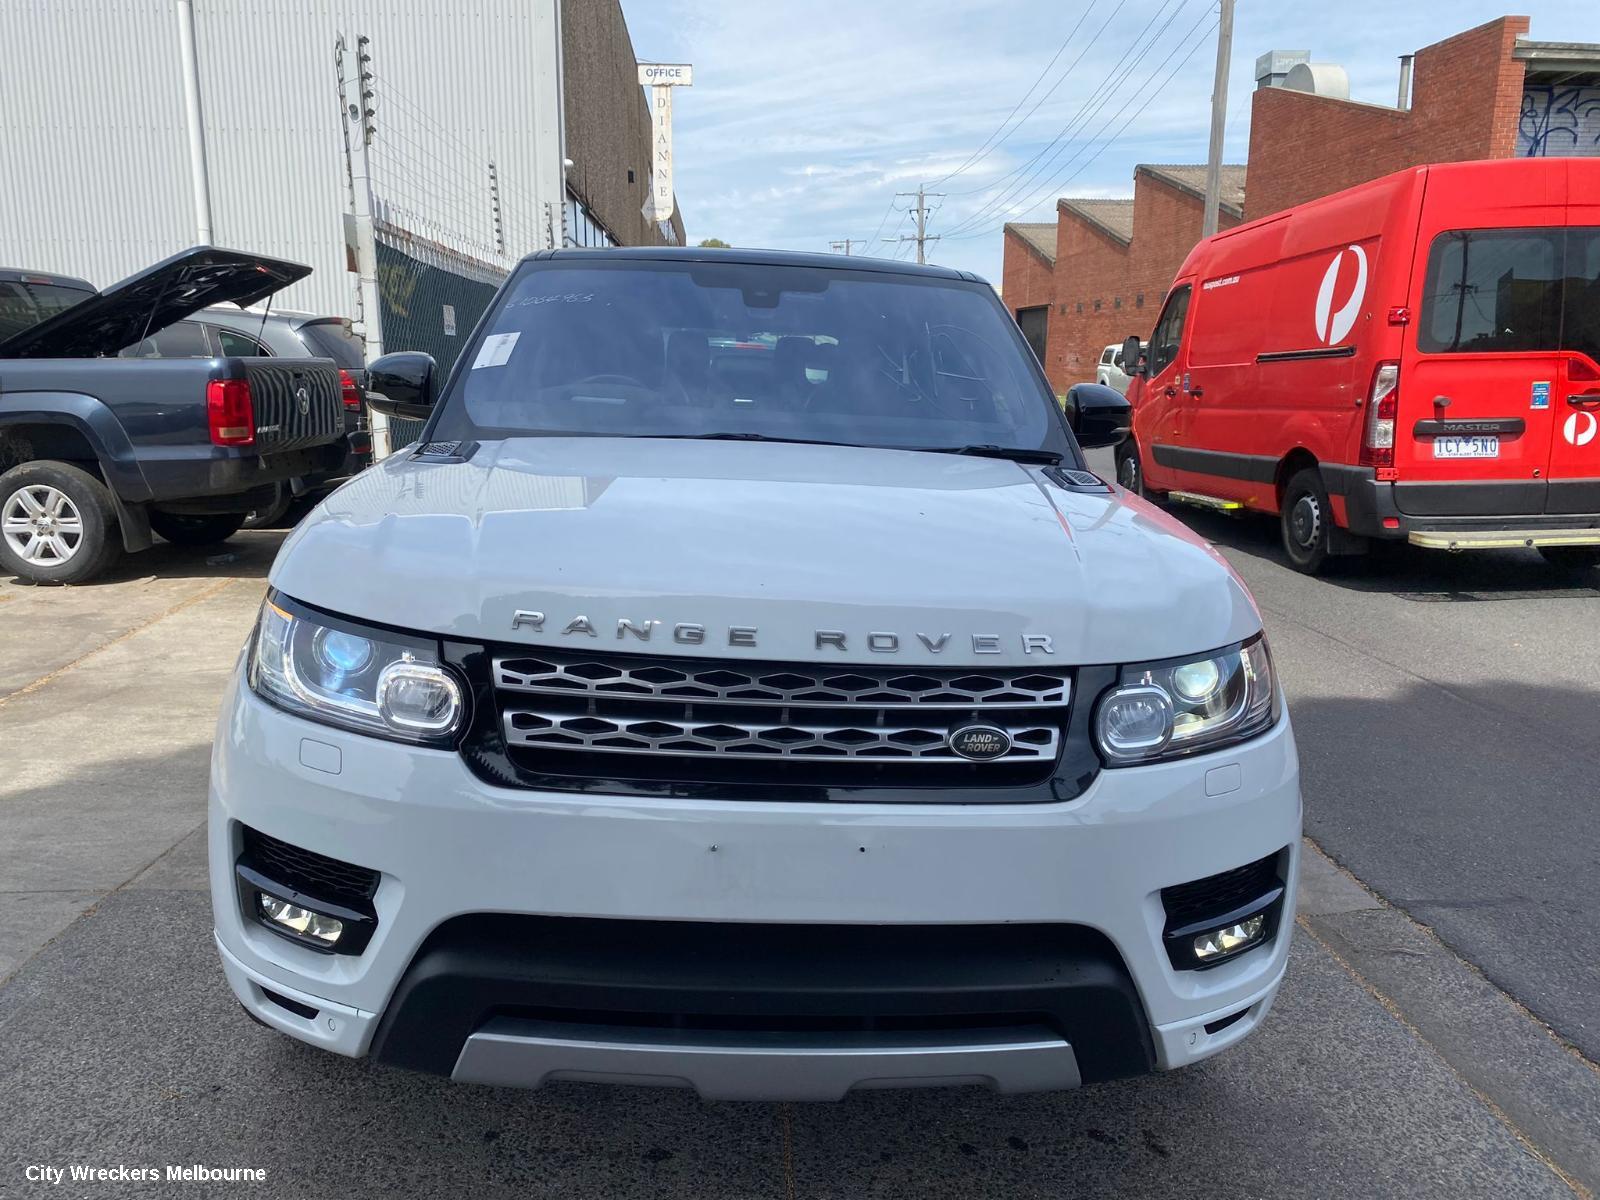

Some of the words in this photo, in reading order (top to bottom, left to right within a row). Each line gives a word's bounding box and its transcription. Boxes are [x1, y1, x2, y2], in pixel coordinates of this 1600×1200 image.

[645, 68, 682, 78] OFFICE
[657, 97, 668, 197] DIANNE
[1443, 423, 1500, 431] MASTER
[512, 609, 758, 648] RANGE
[815, 629, 1054, 654] ROVER
[966, 743, 1000, 752] ROVER
